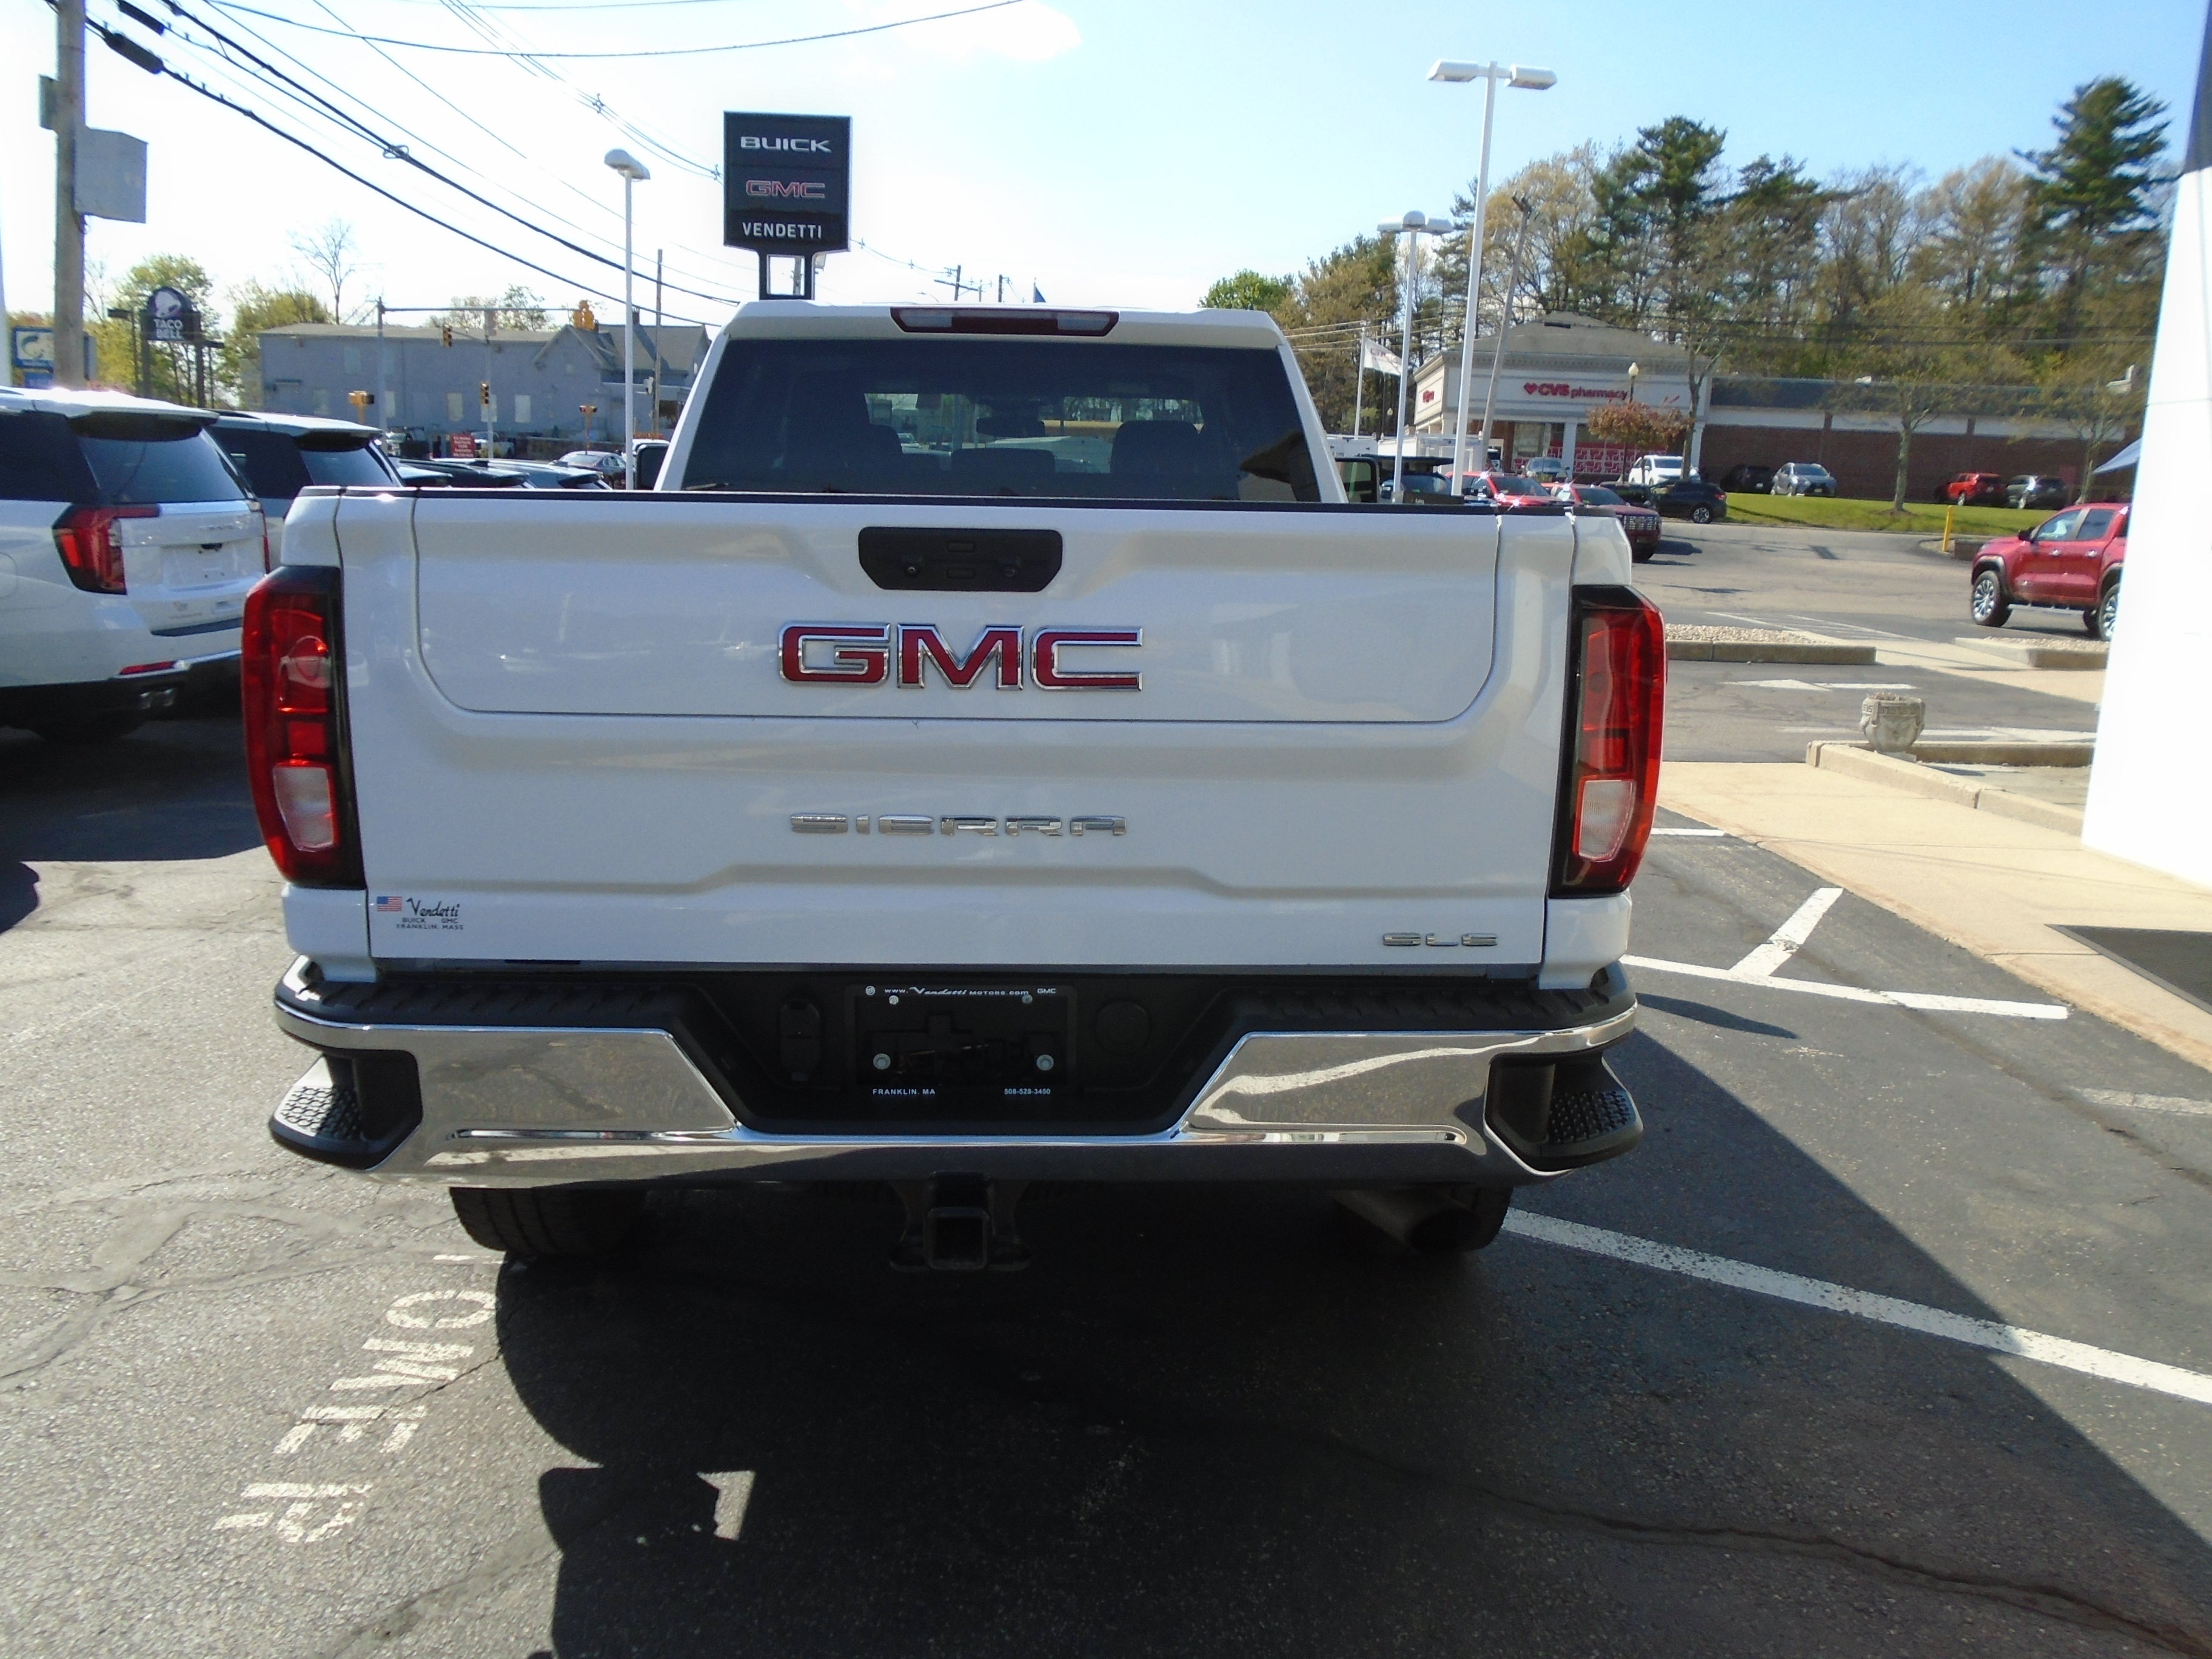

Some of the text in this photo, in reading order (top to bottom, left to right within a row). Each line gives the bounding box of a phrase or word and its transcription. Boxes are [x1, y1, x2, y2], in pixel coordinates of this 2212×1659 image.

[740, 136, 832, 153] BUICK
[746, 179, 825, 199] GMC
[742, 222, 822, 239] VENDETTI
[153, 319, 183, 330] TACO
[156, 329, 183, 340] BELL
[1538, 383, 1629, 400] CVS pharmacy
[778, 620, 1143, 691] GMC
[791, 813, 1127, 836] SIERRA
[406, 898, 460, 917] Vendetti
[1383, 933, 1498, 947] SLE
